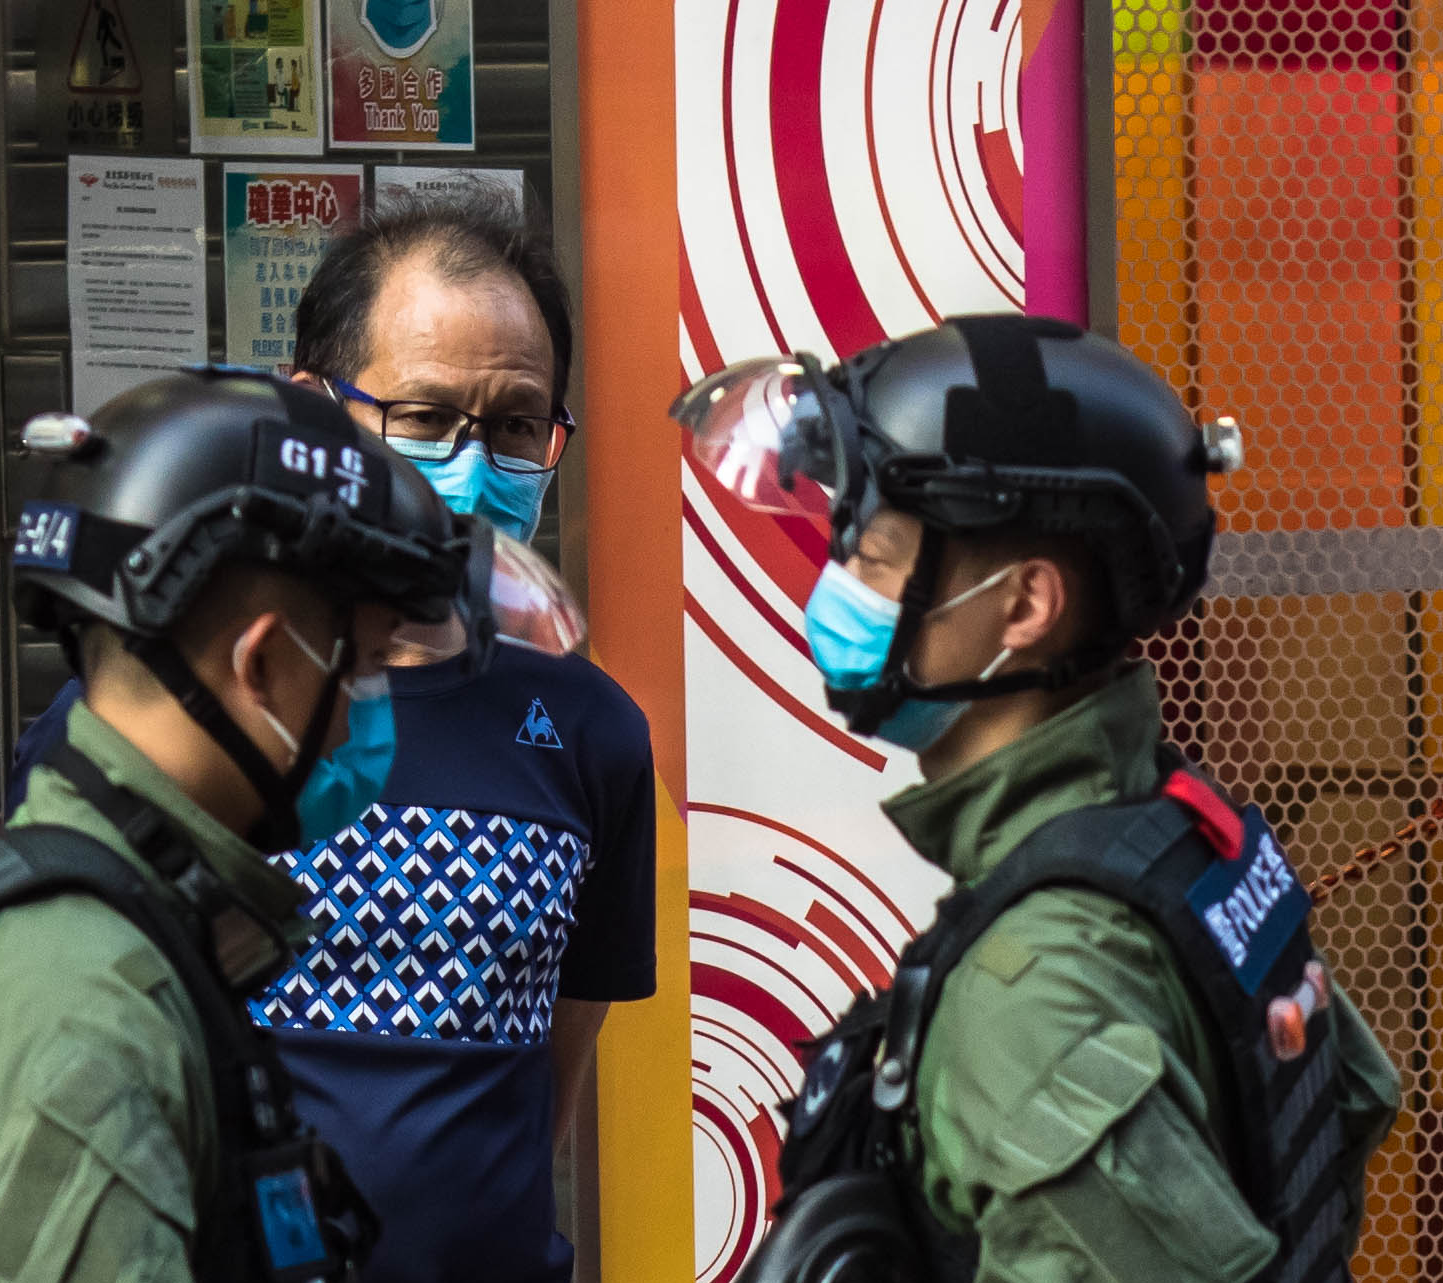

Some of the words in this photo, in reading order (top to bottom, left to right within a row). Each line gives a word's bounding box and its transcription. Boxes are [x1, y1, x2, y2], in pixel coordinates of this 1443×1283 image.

[358, 64, 444, 100] 多謝合作
[364, 101, 406, 131] Thank
[411, 103, 439, 132] You
